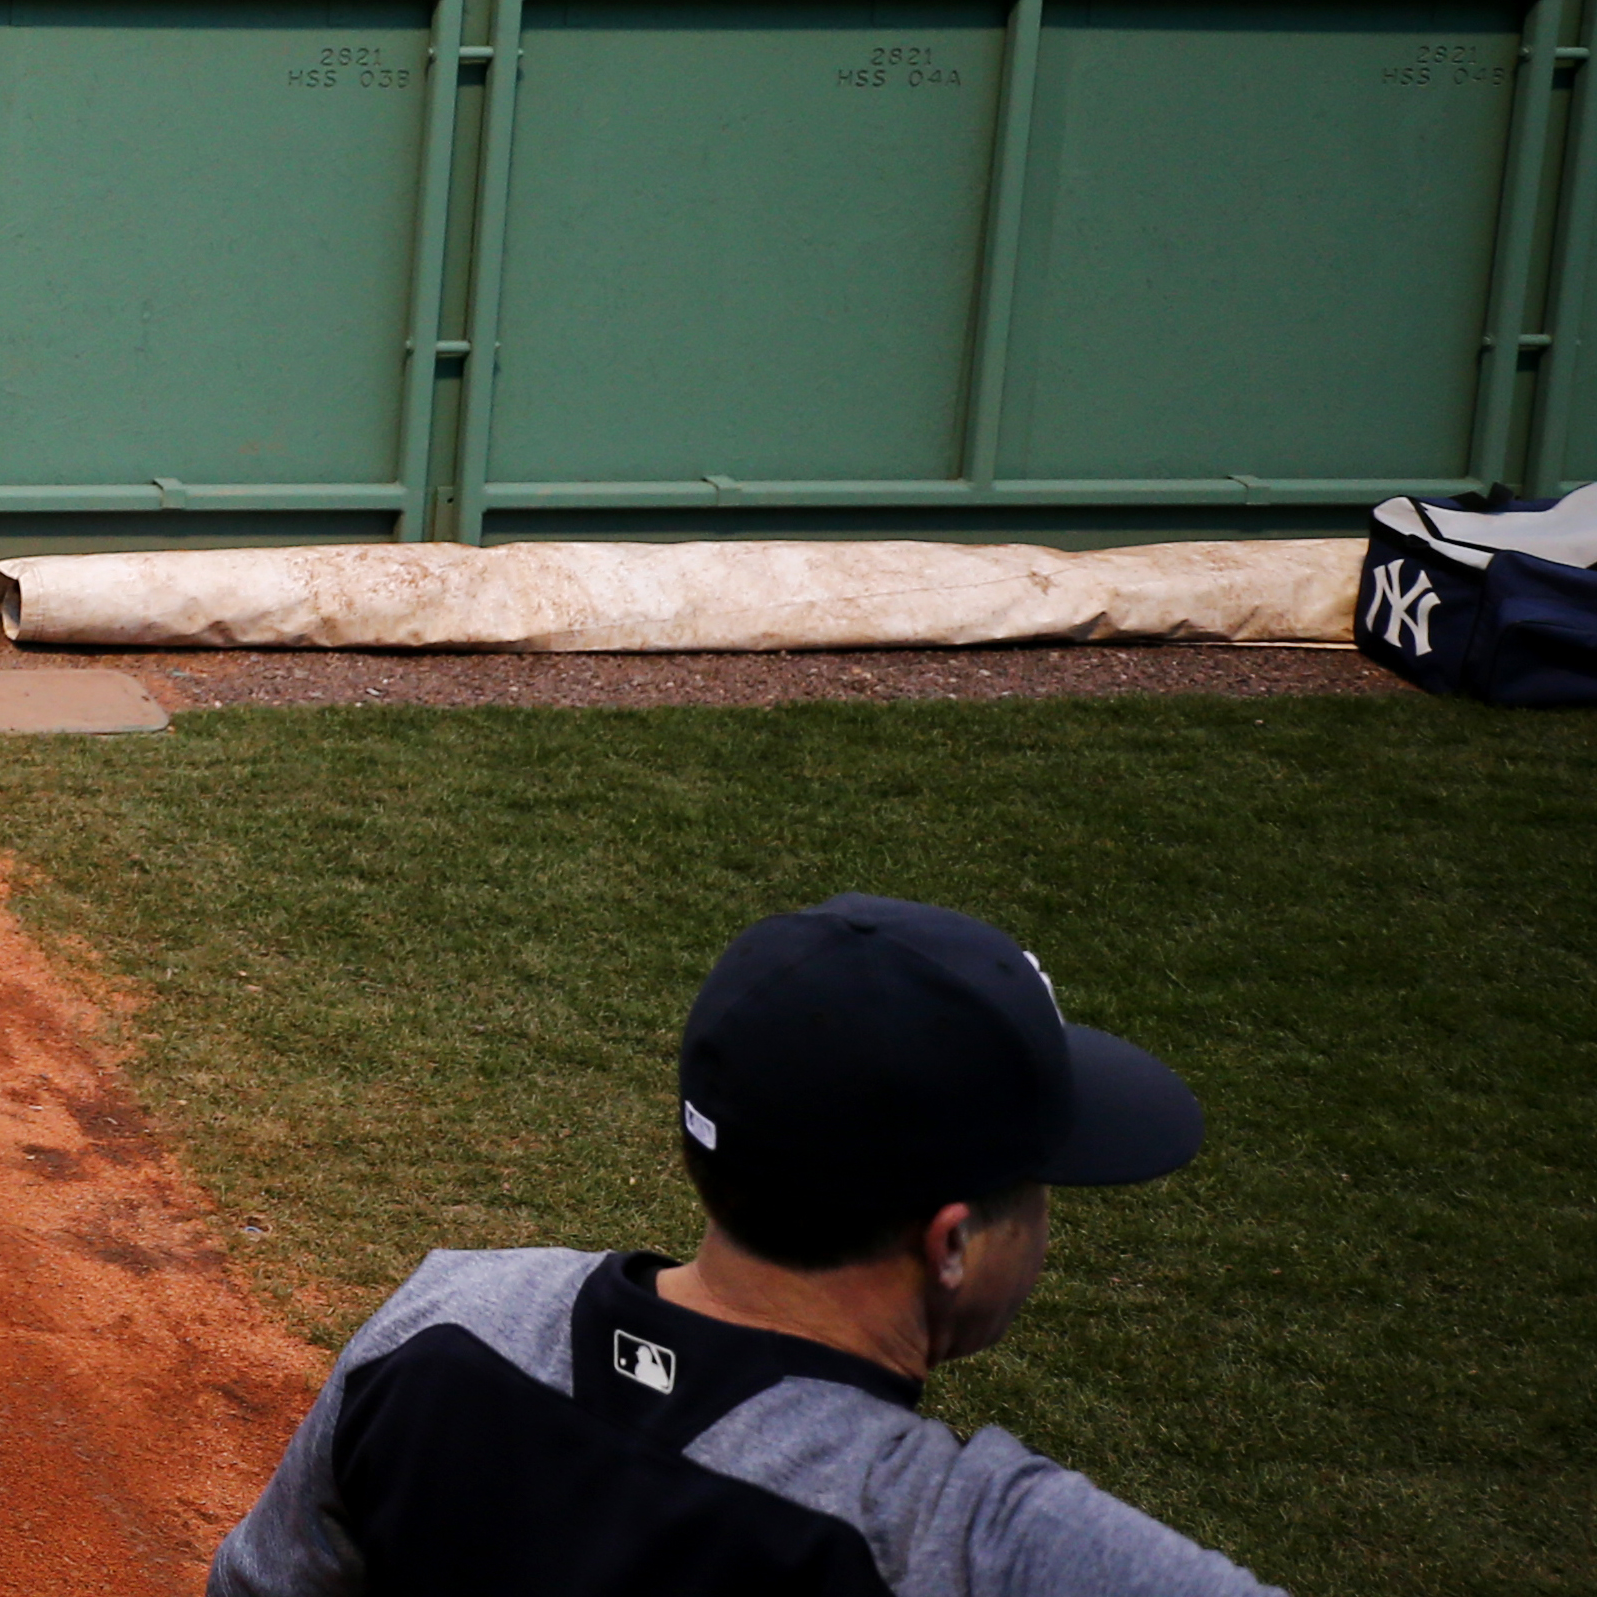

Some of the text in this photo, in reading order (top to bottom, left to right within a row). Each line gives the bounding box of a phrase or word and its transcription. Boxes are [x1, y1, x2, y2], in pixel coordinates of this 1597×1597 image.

[320, 47, 381, 66] 2821
[871, 47, 932, 66] 2821
[288, 69, 337, 88] HSS
[838, 69, 886, 87] HSS
